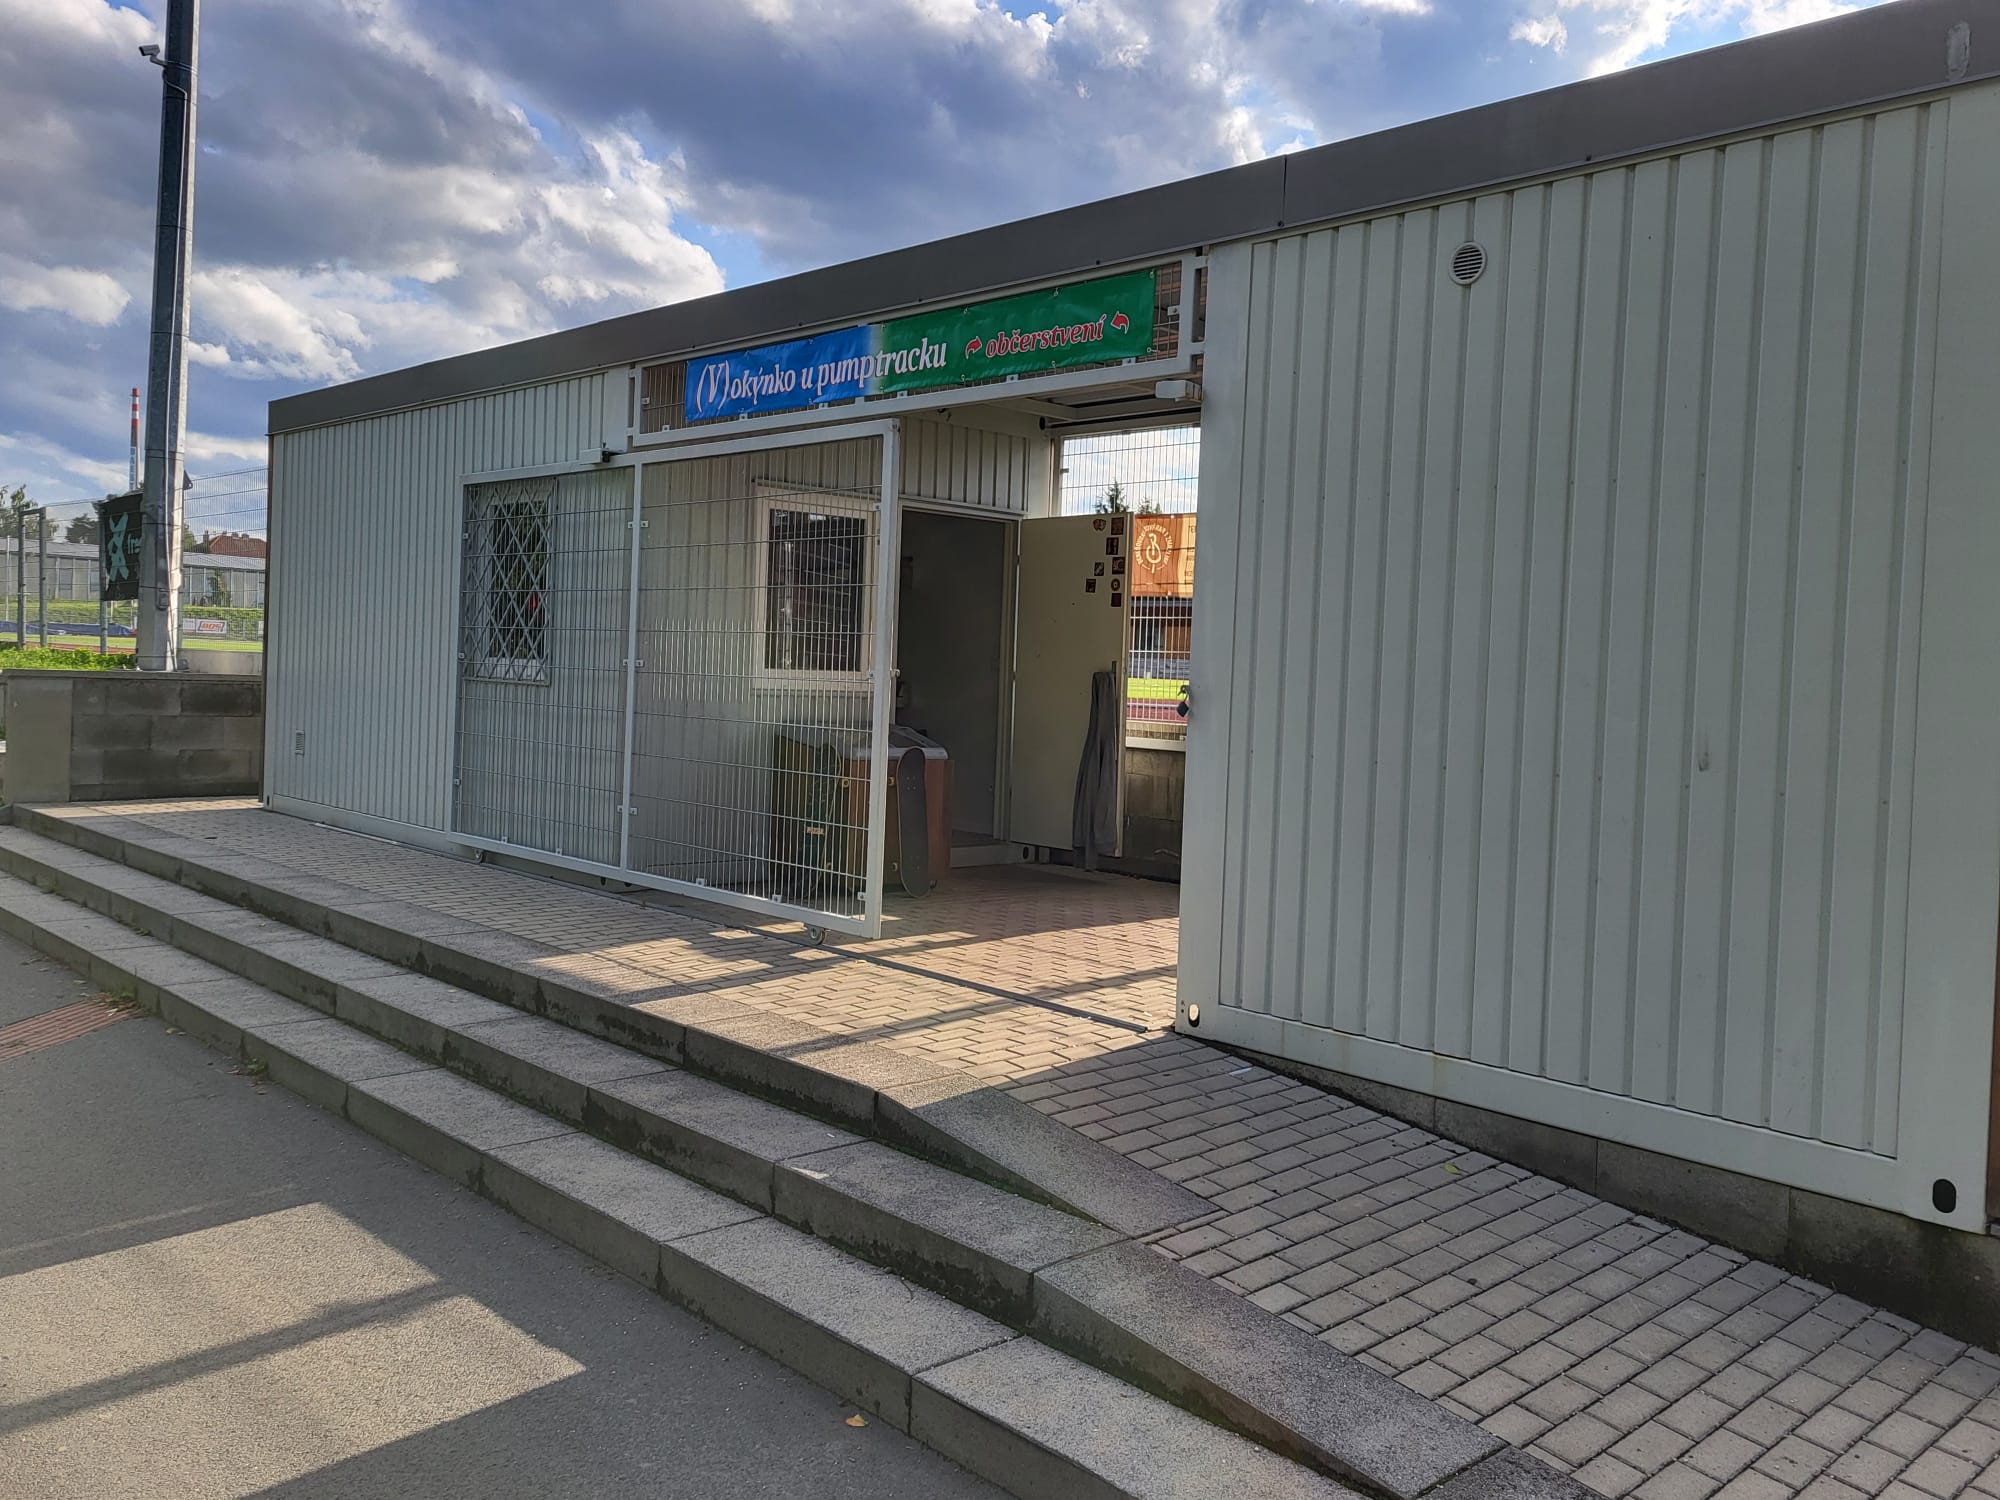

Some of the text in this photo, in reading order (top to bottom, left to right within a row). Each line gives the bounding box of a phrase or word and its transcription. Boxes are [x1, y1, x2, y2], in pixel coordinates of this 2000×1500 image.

[985, 313, 1108, 359] občerstvení
[696, 337, 947, 413] (V)okýnko u pumptracku
